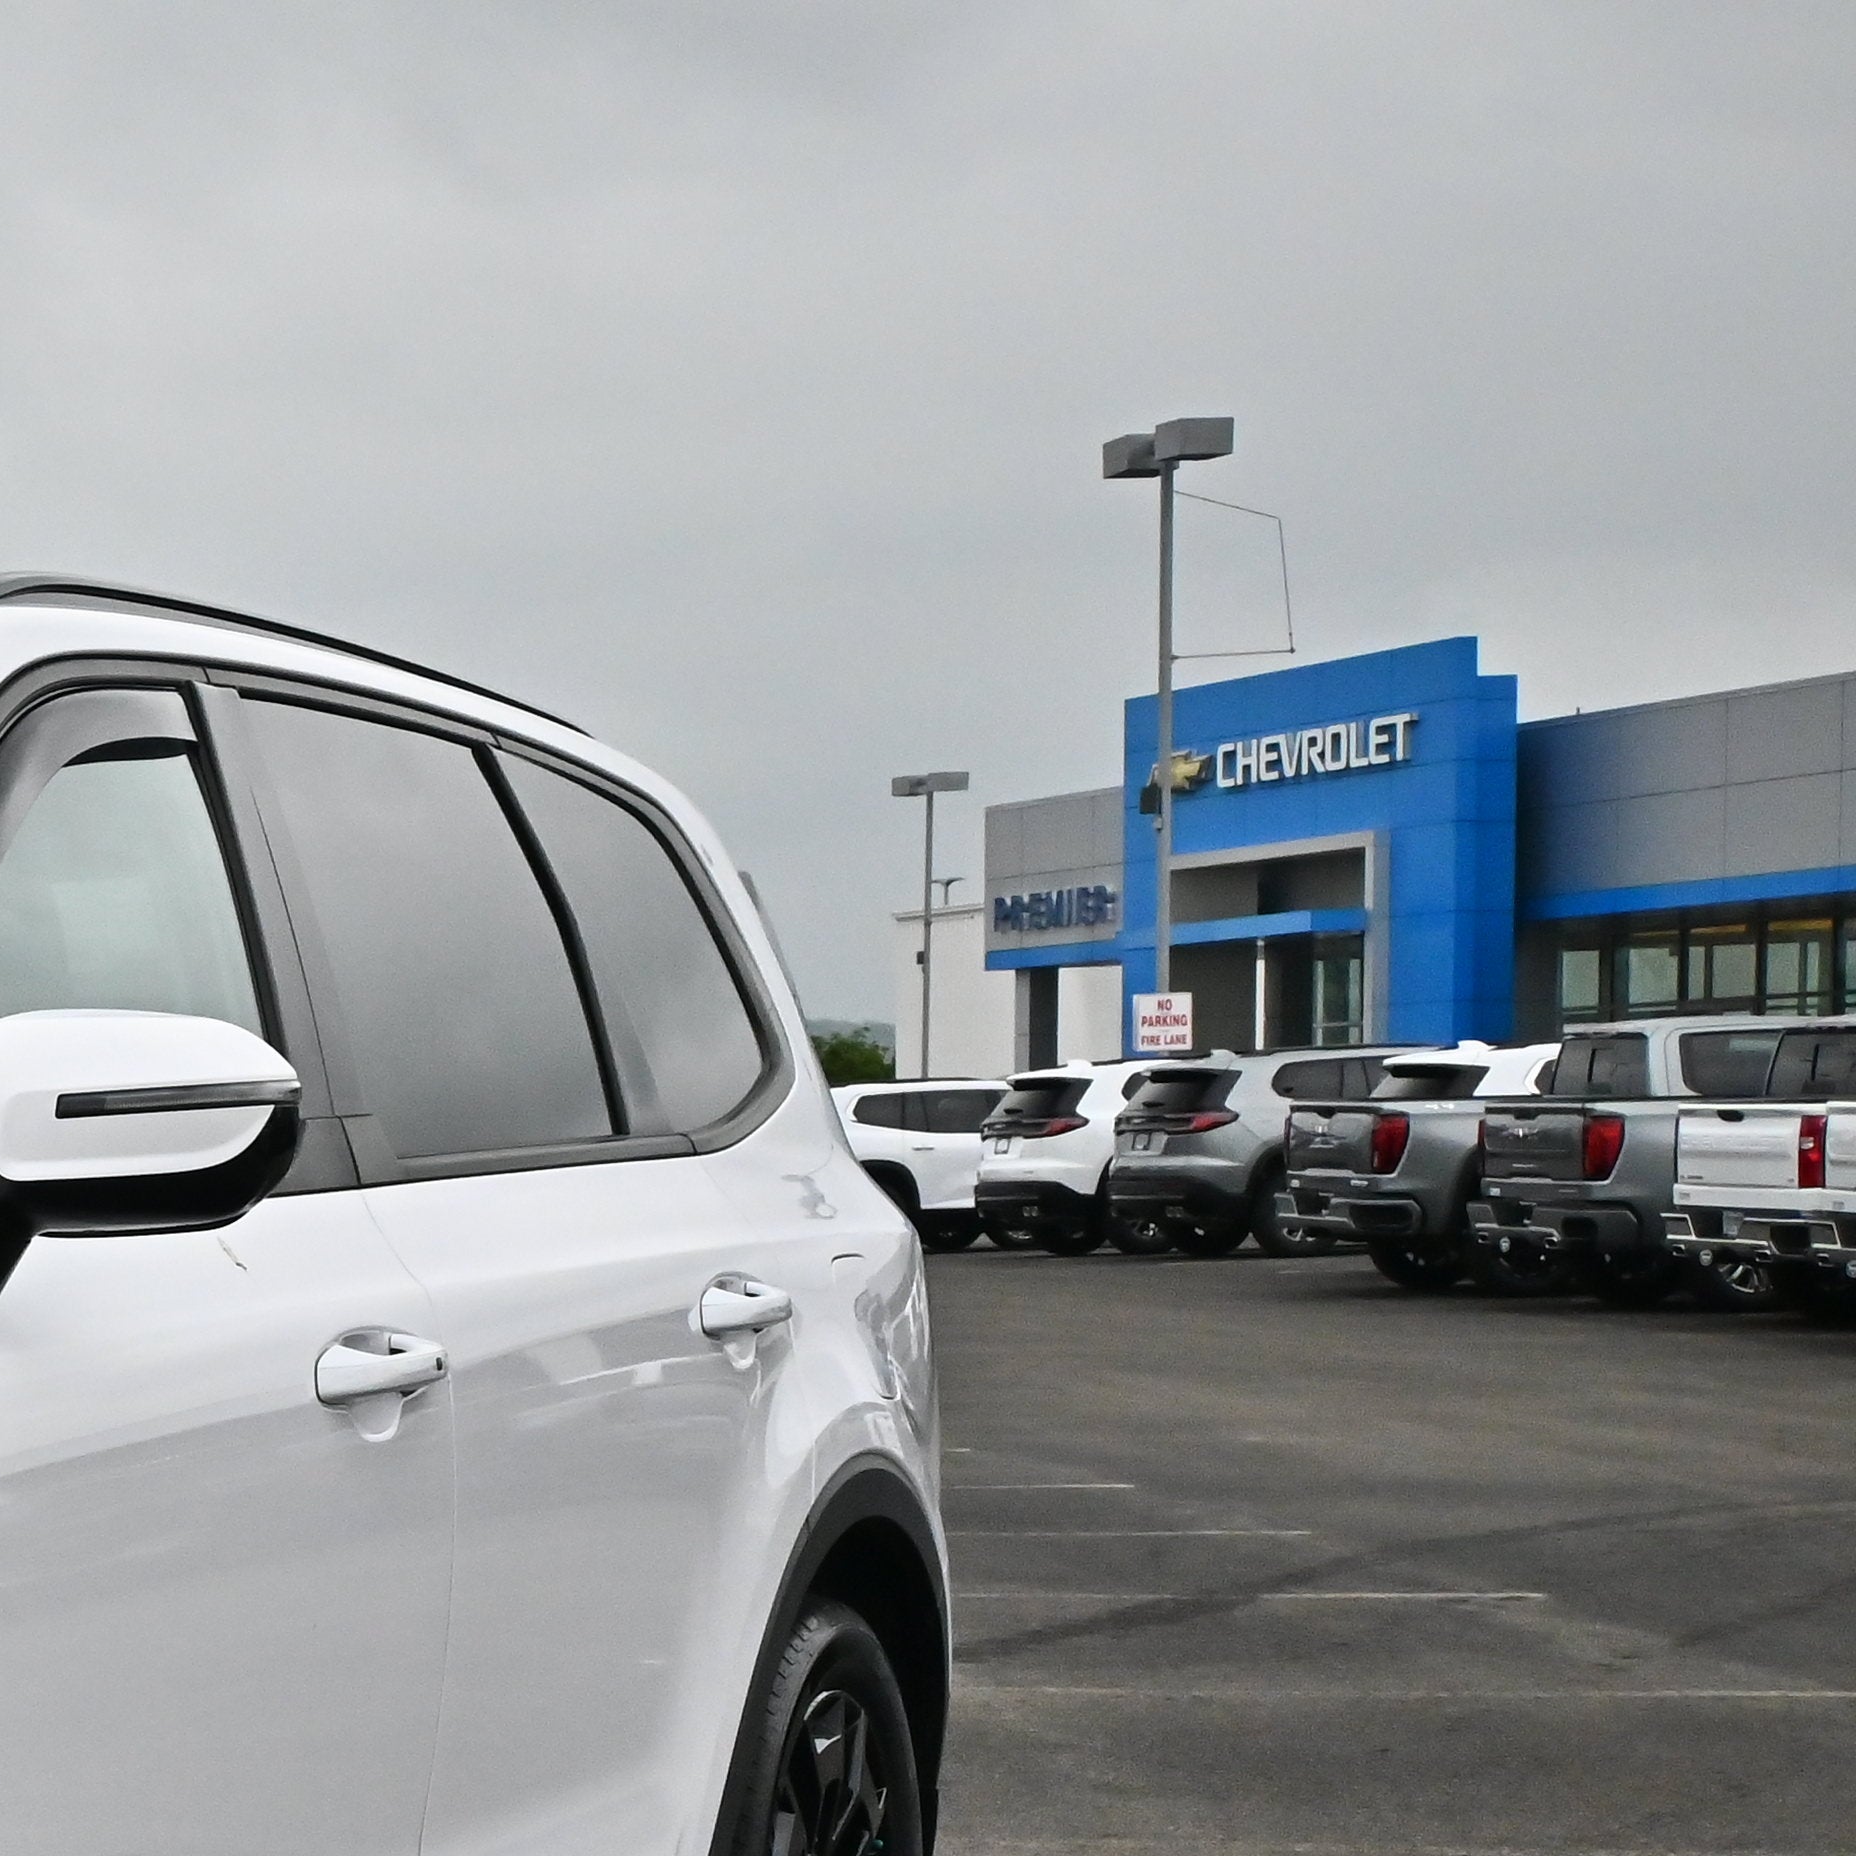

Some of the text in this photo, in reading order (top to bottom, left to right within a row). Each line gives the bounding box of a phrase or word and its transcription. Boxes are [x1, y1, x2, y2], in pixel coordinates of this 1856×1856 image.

[1217, 712, 1418, 788] CHEVROLET
[1157, 998, 1172, 1011] NO
[1141, 1014, 1188, 1028] PARKING
[1141, 1034, 1187, 1046] FIRE LANE
